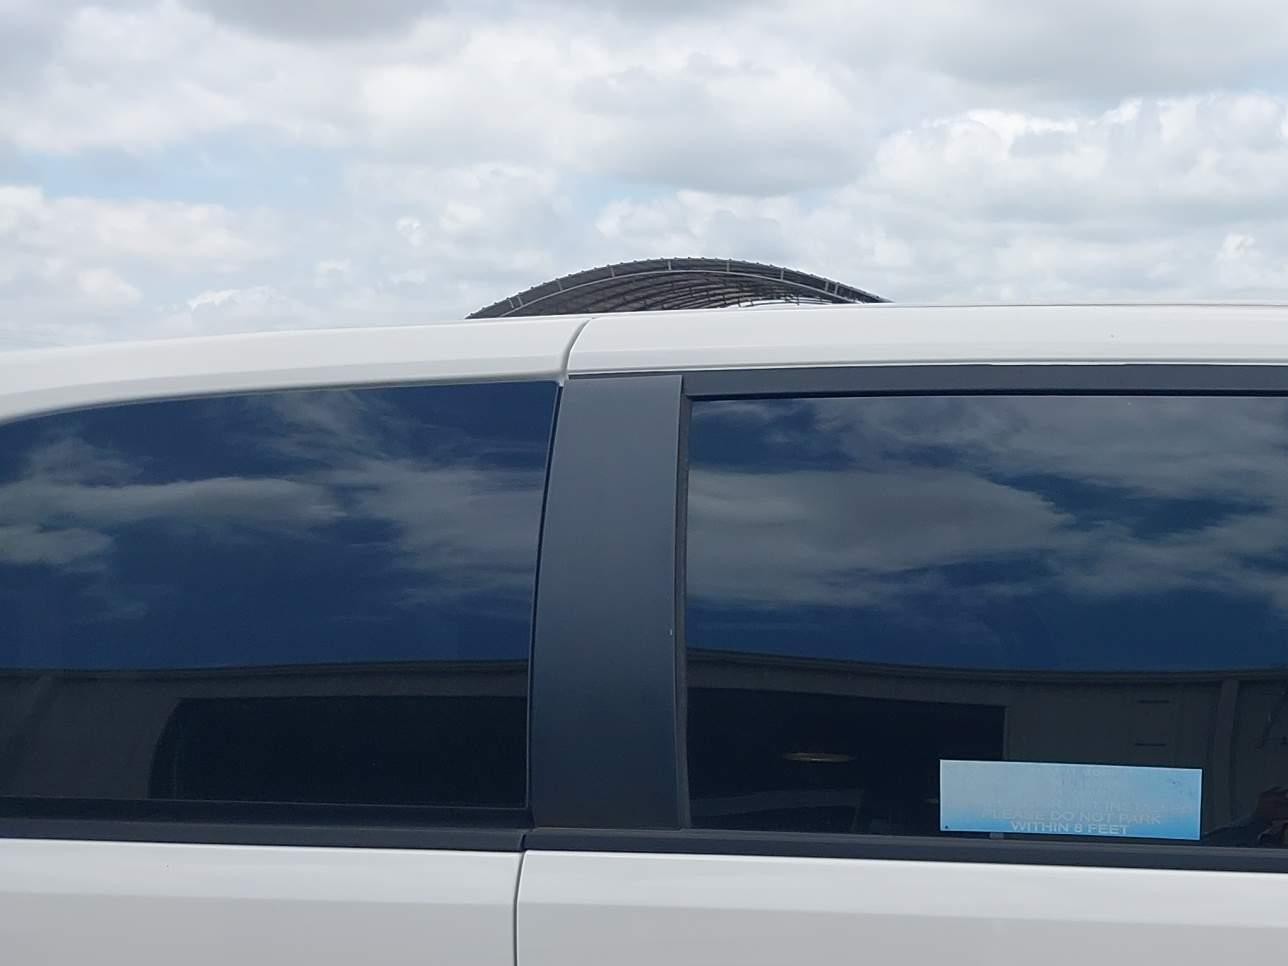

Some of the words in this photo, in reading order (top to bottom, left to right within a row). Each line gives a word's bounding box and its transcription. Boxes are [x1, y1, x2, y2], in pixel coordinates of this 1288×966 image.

[1050, 811, 1074, 821] DO
[1080, 812, 1112, 823] NOT
[1119, 813, 1160, 825] PARK
[1010, 820, 1067, 833] WITHIN
[1088, 823, 1127, 835] FEET
